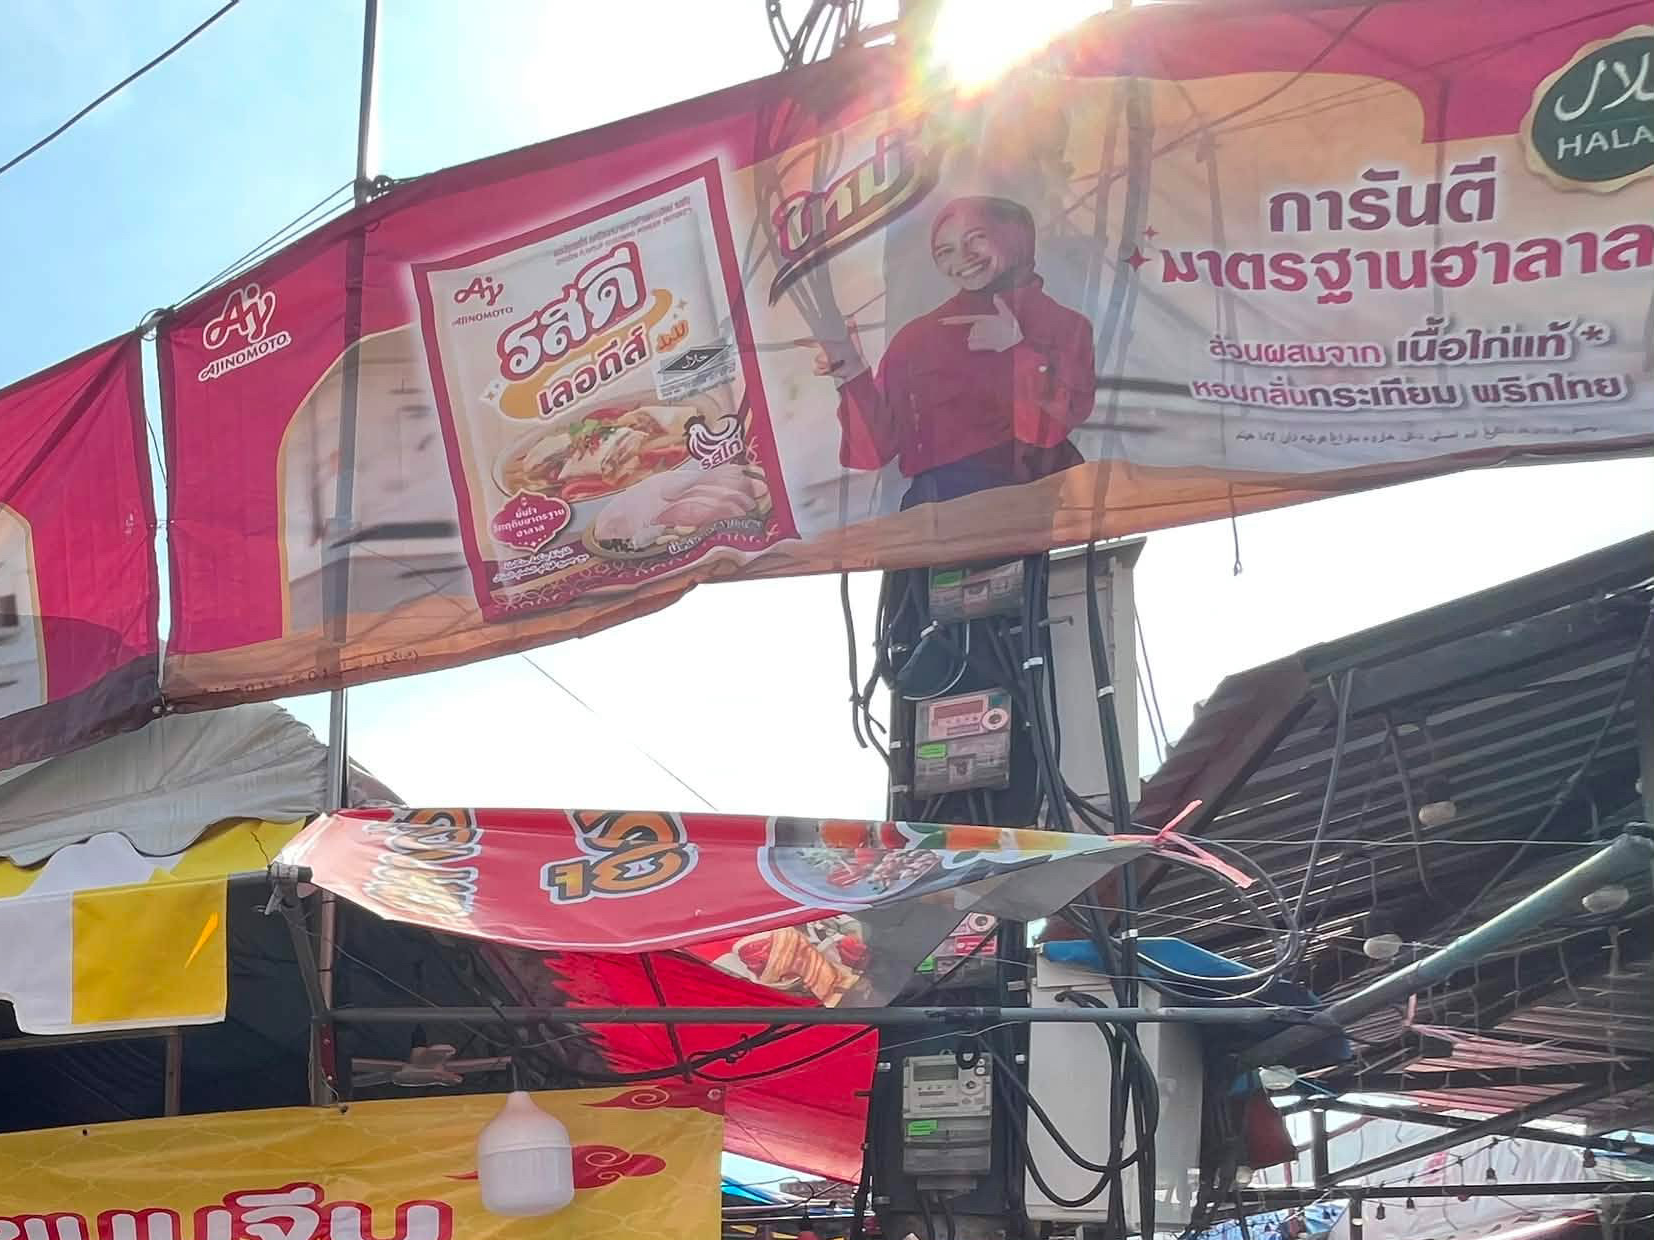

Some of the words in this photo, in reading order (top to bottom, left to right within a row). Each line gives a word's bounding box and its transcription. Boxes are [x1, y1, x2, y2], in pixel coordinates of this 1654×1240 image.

[1554, 52, 1654, 122] لال
[1556, 125, 1654, 160] HALA
[1269, 156, 1499, 233] การันตี
[1160, 222, 1654, 305] มาตรฐานฮาลาล
[452, 306, 514, 326] AJINOMOTO
[498, 241, 646, 382] รสดี
[199, 333, 288, 379] AJINOMOTO
[1209, 334, 1381, 364] ส่วนผสมจาก
[1192, 375, 1458, 409] หอมกลิ่นกระเทียม
[1471, 372, 1621, 407] พริกไทย
